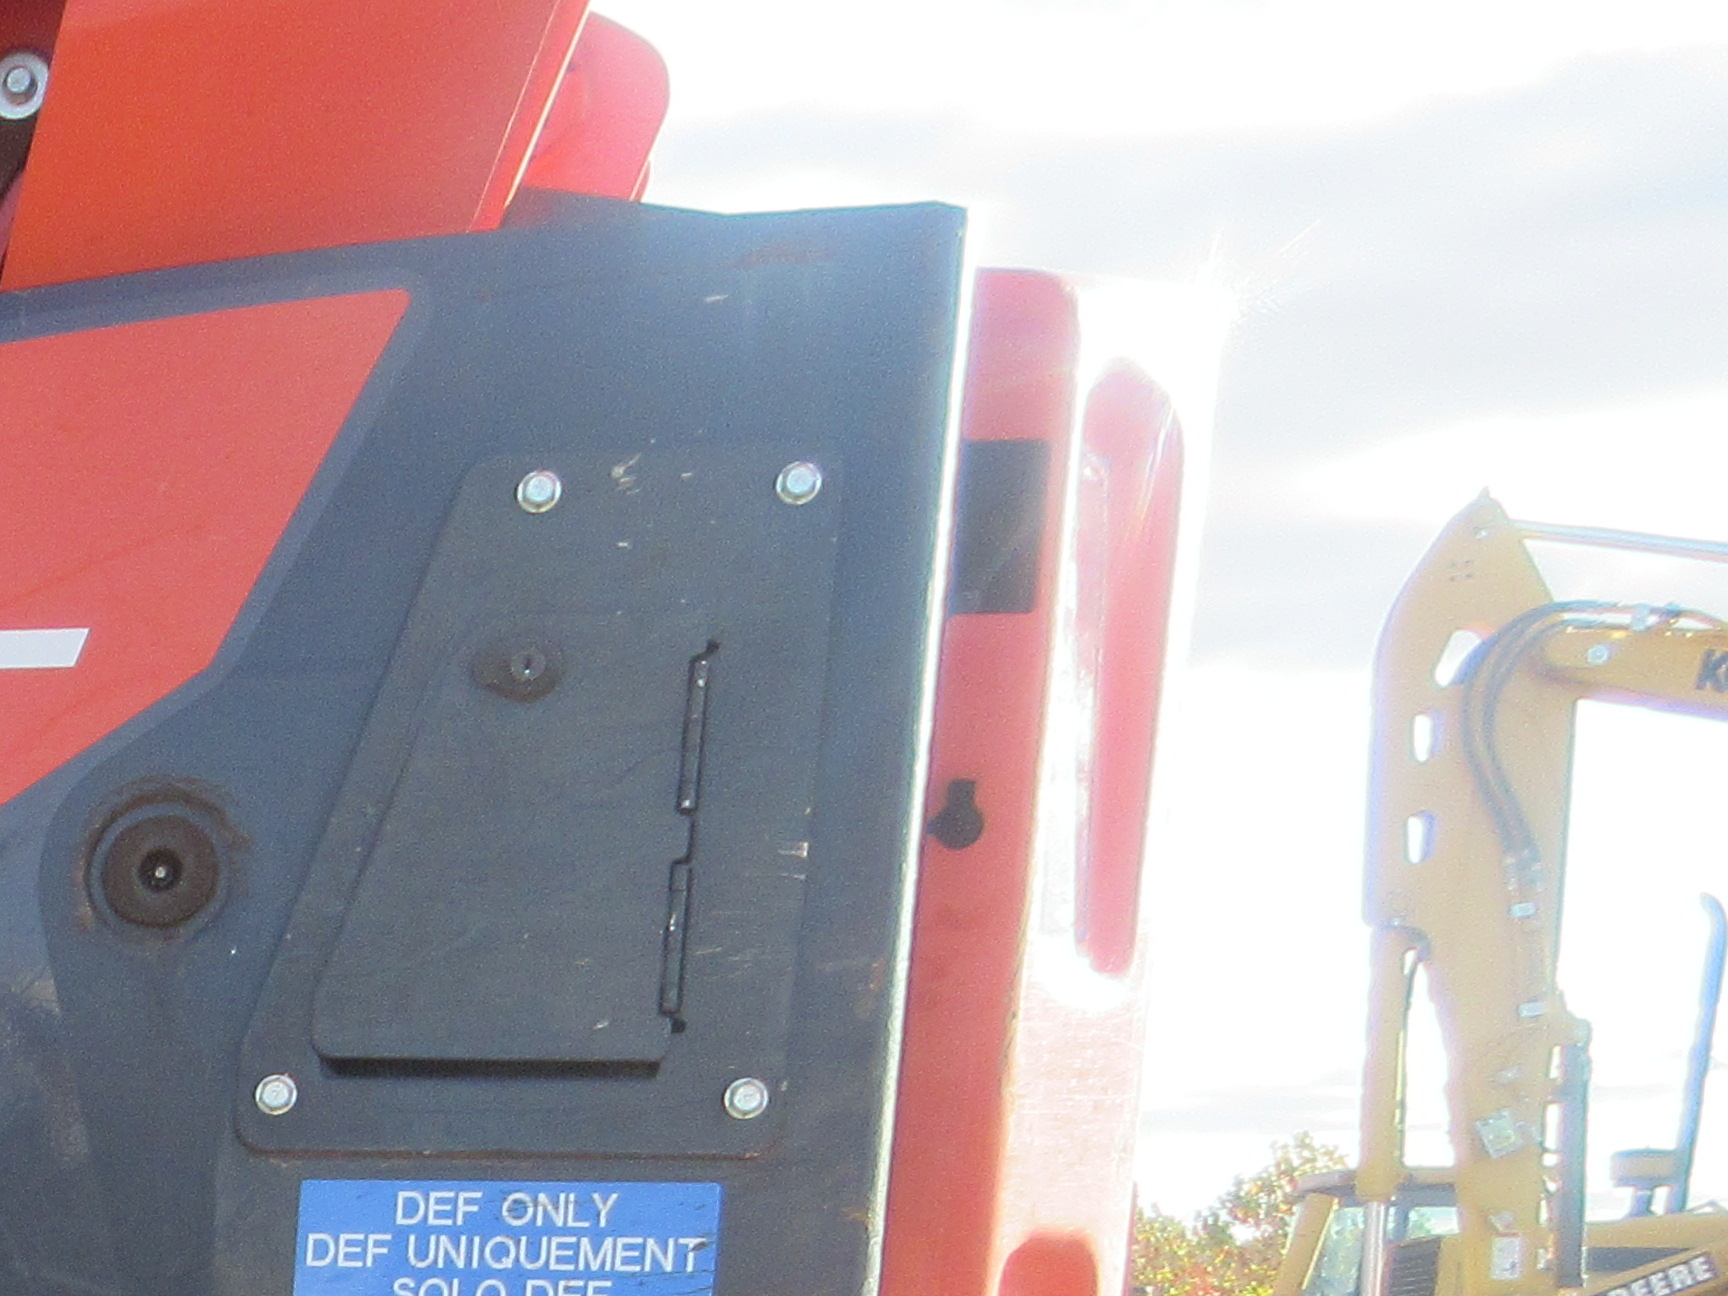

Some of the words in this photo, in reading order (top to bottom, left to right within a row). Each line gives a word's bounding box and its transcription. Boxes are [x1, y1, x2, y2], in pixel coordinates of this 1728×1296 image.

[395, 1190, 484, 1227] DEF
[502, 1191, 619, 1228] ONLY
[305, 1232, 392, 1268] DEF
[407, 1234, 707, 1273] UNIQUEMENT
